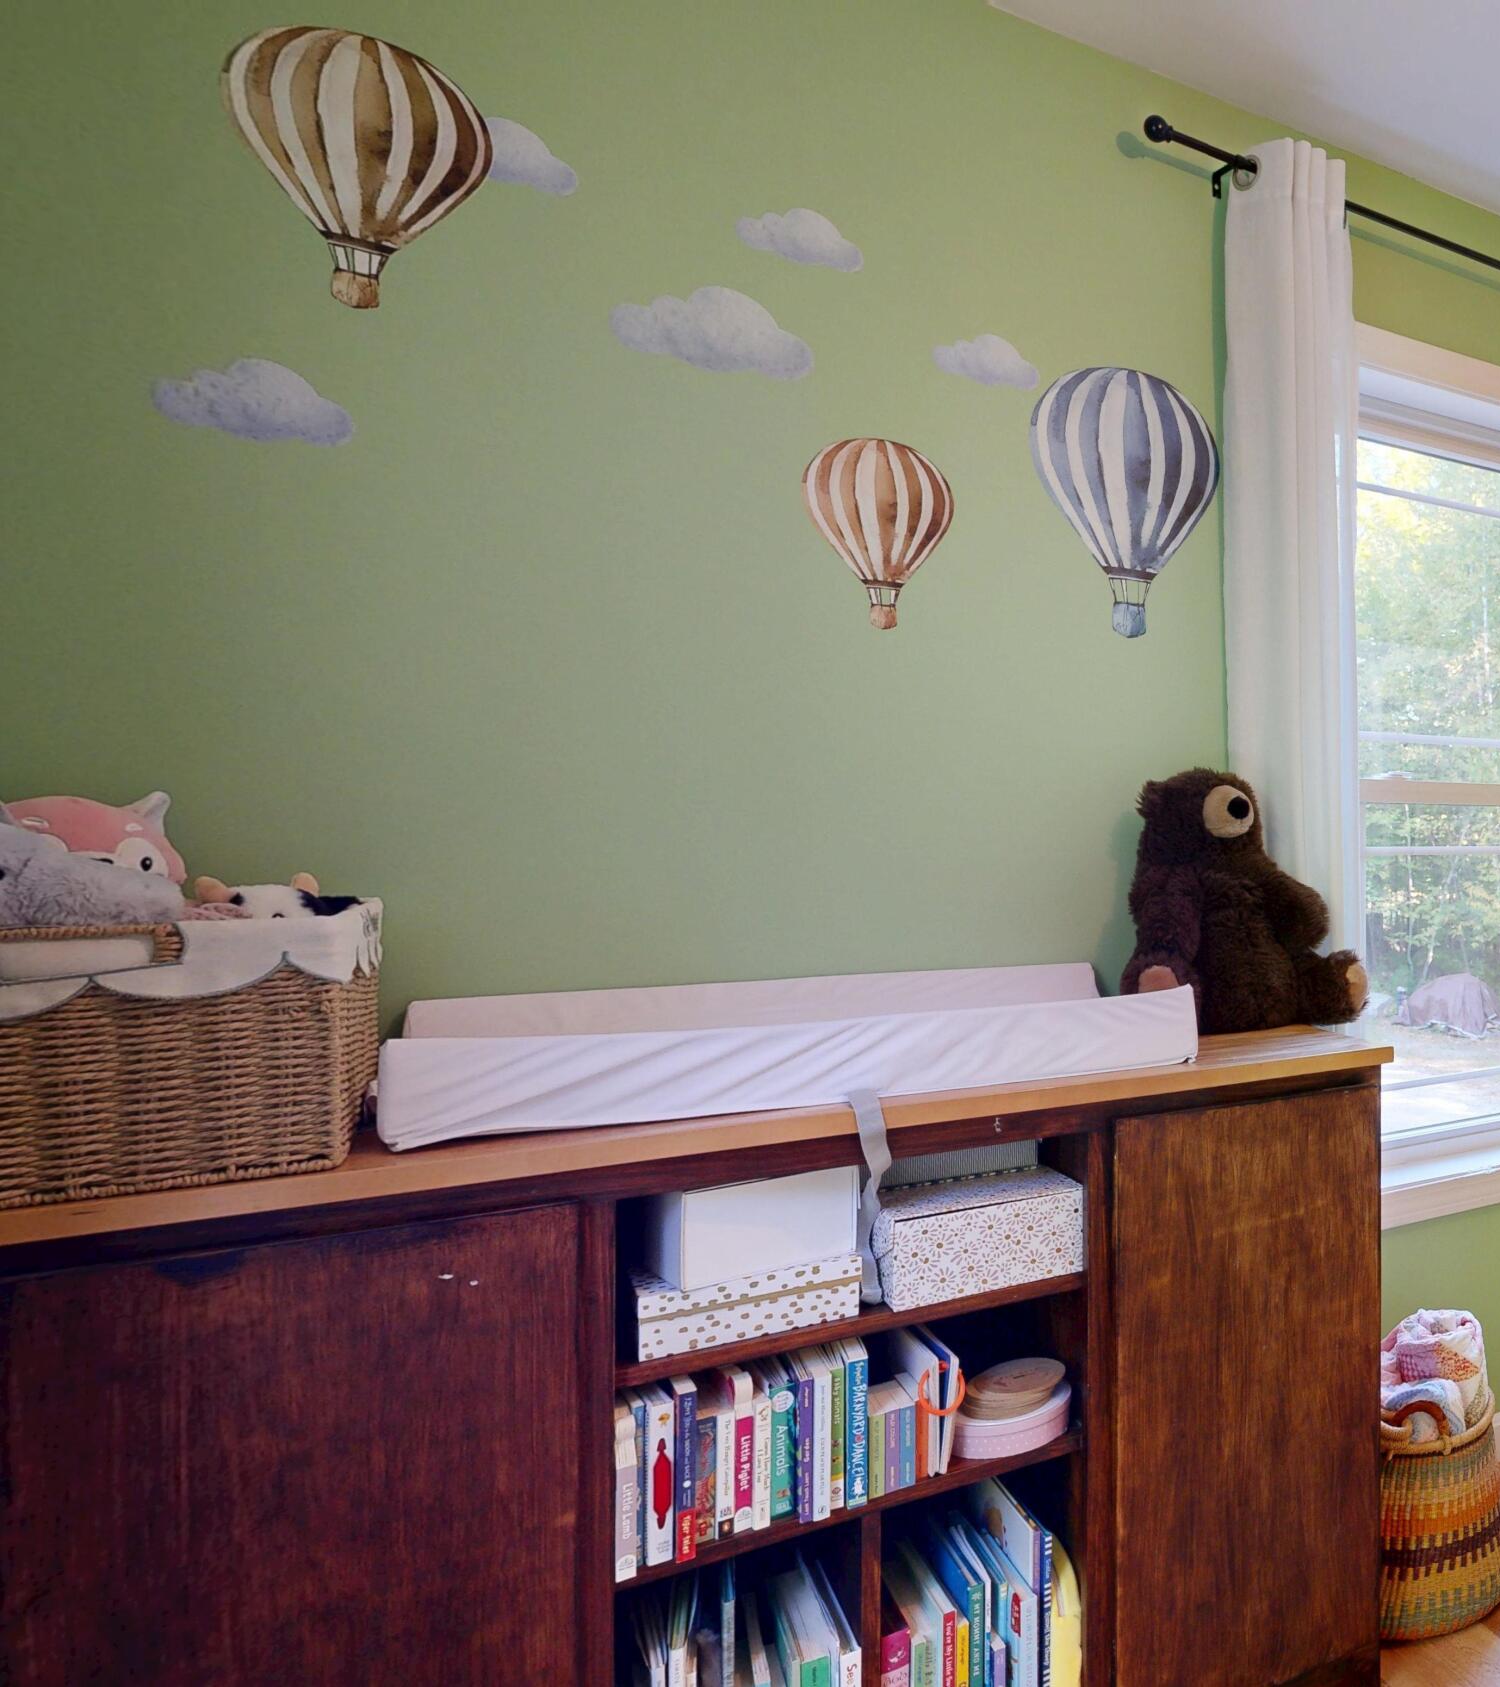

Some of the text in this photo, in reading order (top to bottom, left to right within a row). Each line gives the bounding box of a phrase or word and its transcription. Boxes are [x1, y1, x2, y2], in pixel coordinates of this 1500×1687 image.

[852, 1383, 867, 1435] BARNYARD
[739, 1435, 751, 1491] Little Piglet
[775, 1424, 788, 1477] Animals
[622, 1482, 633, 1541] Little Lamb
[973, 1603, 980, 1615] MY
[945, 1620, 953, 1645] You're
[944, 1645, 953, 1660] My
[847, 1663, 858, 1685] See
[973, 1665, 980, 1677] ME
